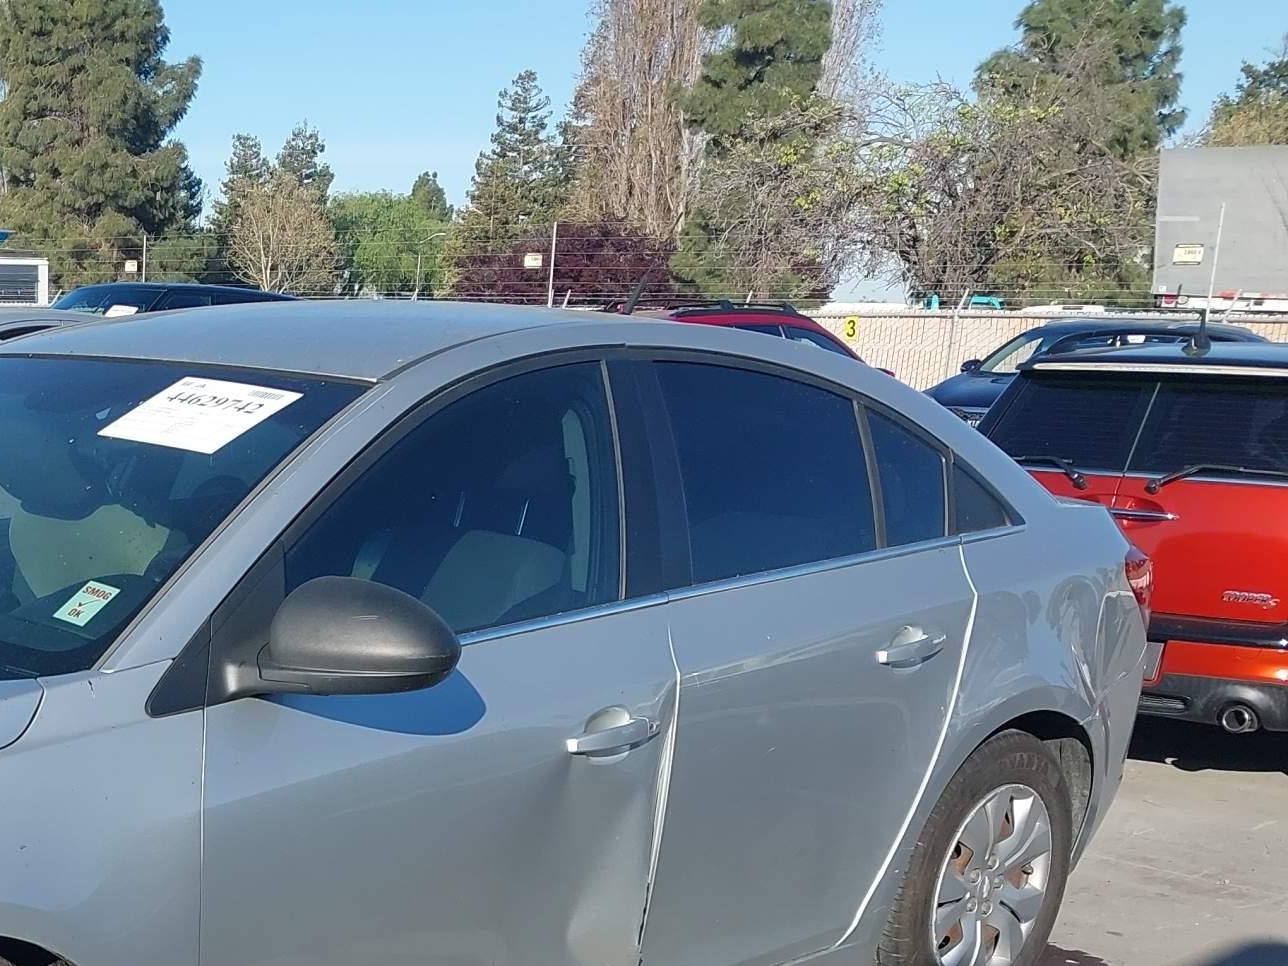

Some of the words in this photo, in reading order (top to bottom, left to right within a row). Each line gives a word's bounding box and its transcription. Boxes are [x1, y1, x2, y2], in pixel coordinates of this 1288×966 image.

[846, 319, 856, 338] 3
[167, 391, 265, 415] 44629742
[82, 585, 112, 601] SMOG
[67, 607, 84, 618] OK
